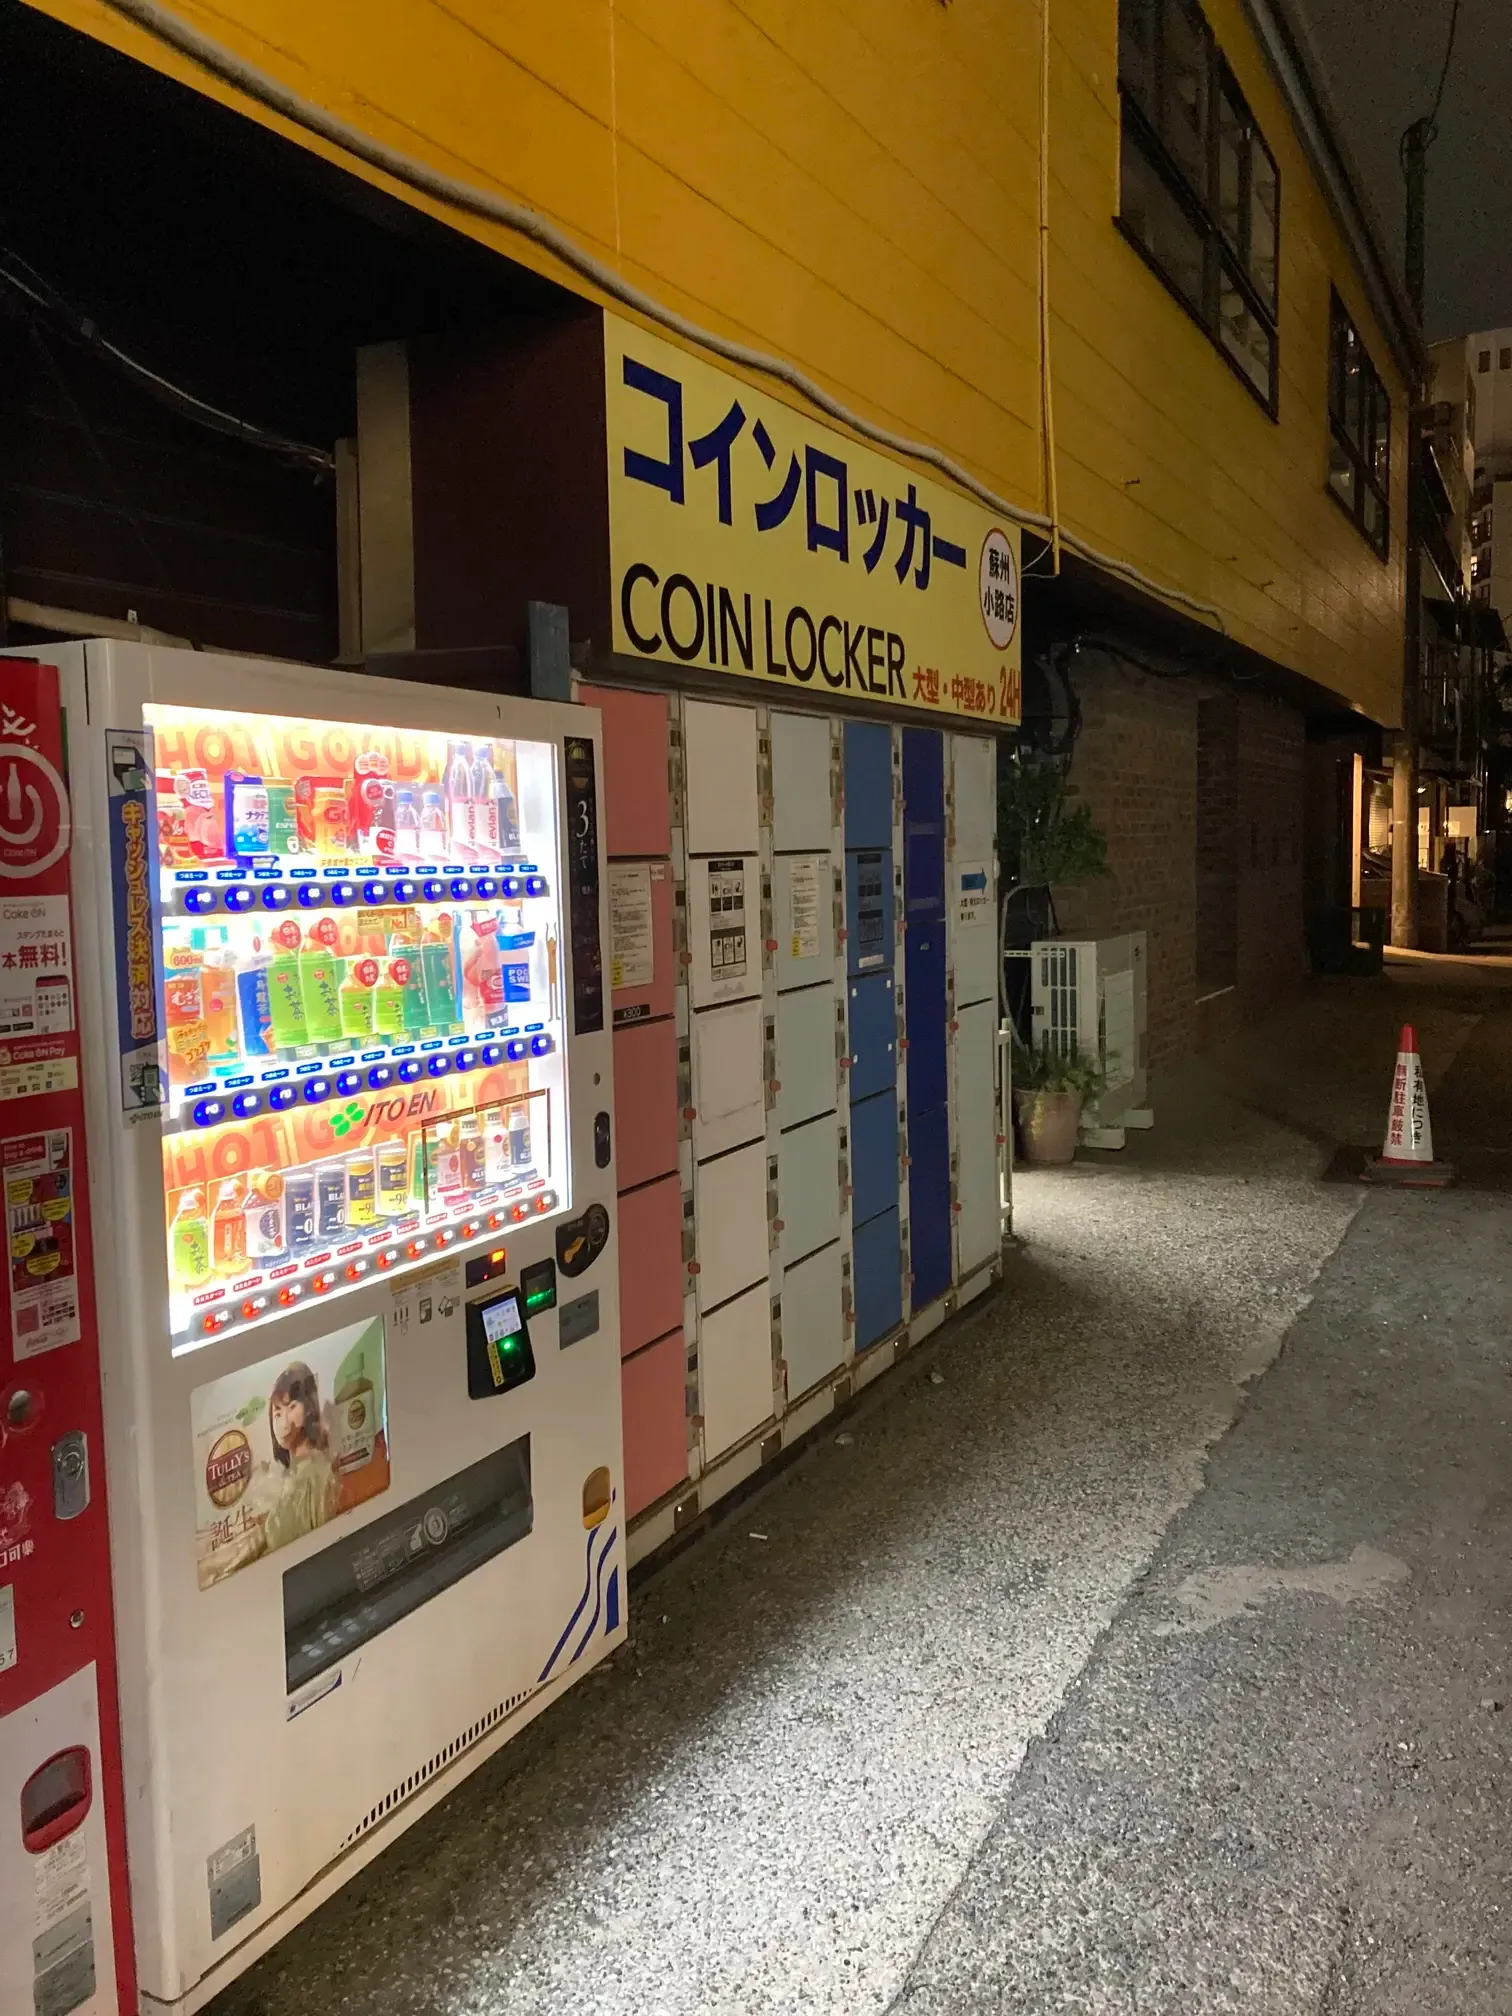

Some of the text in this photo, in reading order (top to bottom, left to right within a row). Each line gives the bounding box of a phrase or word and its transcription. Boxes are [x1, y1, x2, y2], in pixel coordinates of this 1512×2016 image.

[622, 354, 967, 591] コインロッカー
[621, 562, 907, 699] COIN LOCKER
[984, 585, 1015, 624] 小路店
[1000, 664, 1020, 719] 24H
[122, 800, 155, 1038] キャッシュレス決済対応
[363, 1089, 437, 1127] ITO EN
[1390, 1063, 1407, 1146] 無断駐車厳禁
[211, 1505, 256, 1551] 誕生
